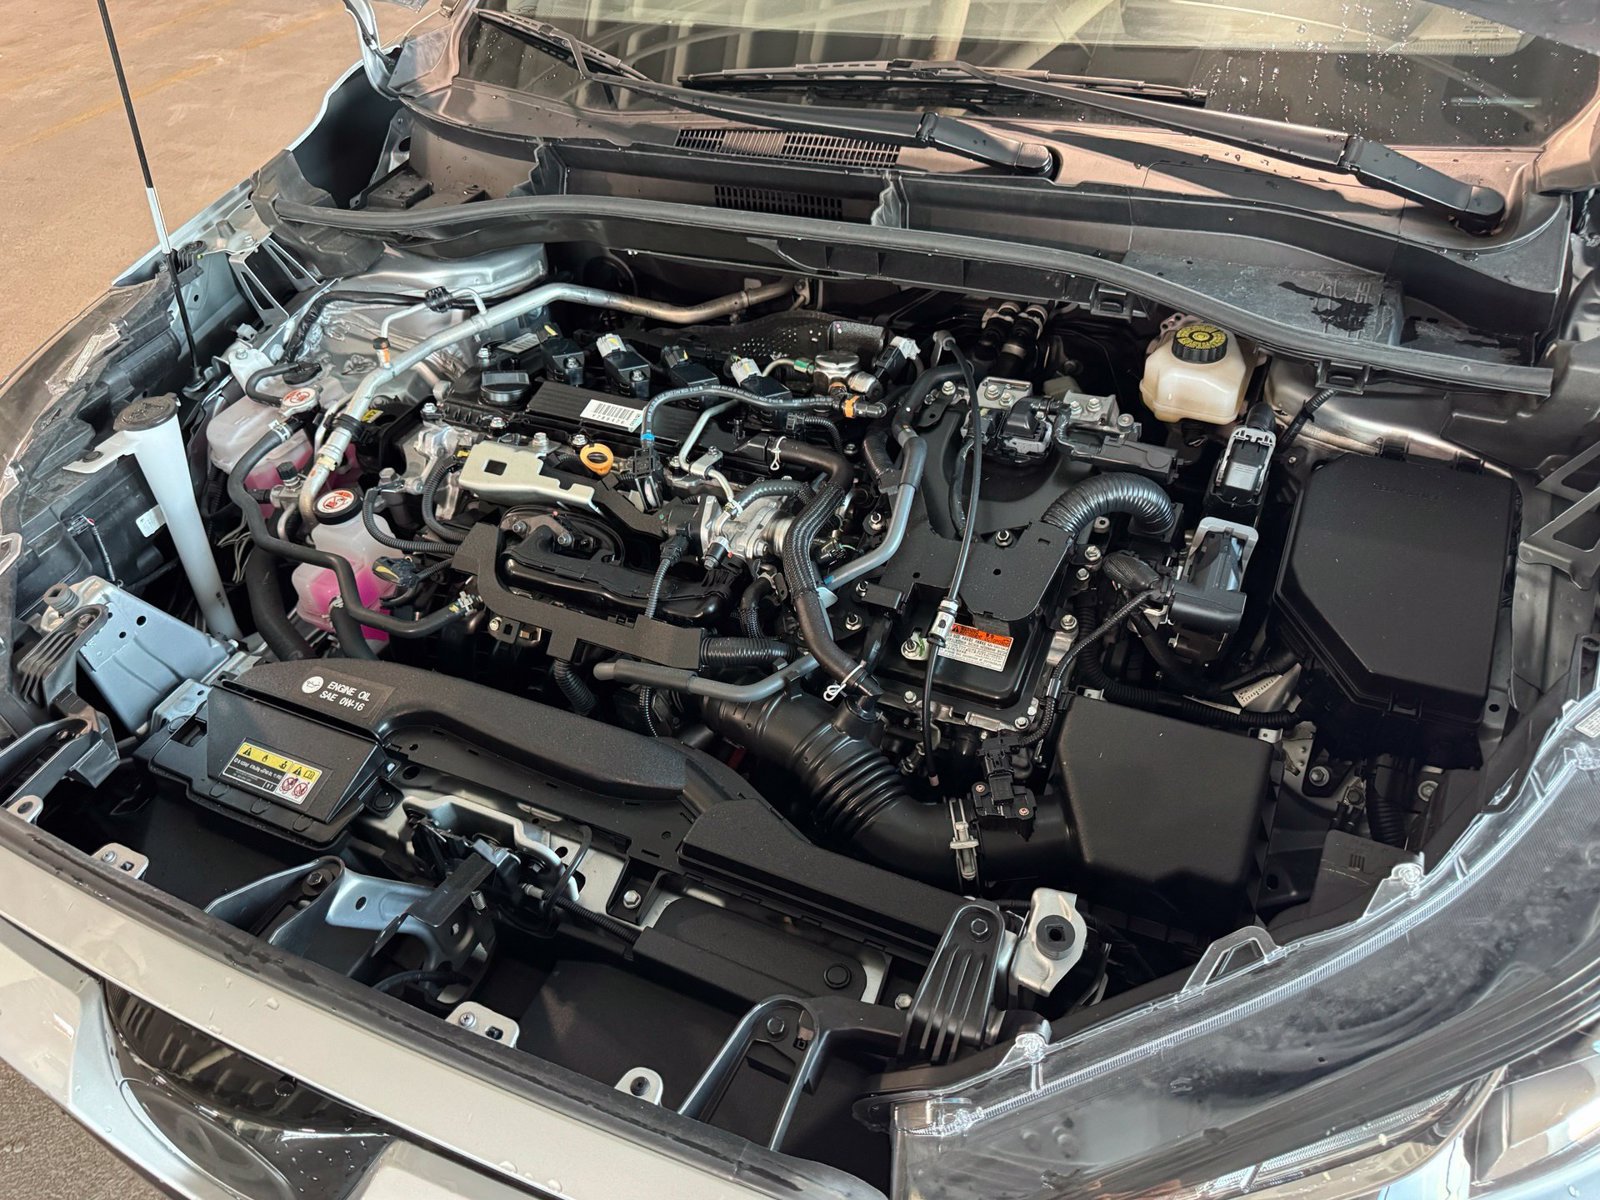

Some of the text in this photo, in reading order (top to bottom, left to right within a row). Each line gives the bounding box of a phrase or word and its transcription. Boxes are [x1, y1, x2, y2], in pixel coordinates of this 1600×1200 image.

[320, 690, 366, 711] SAE 0W-16
[327, 681, 371, 702] ENGINE OIL
